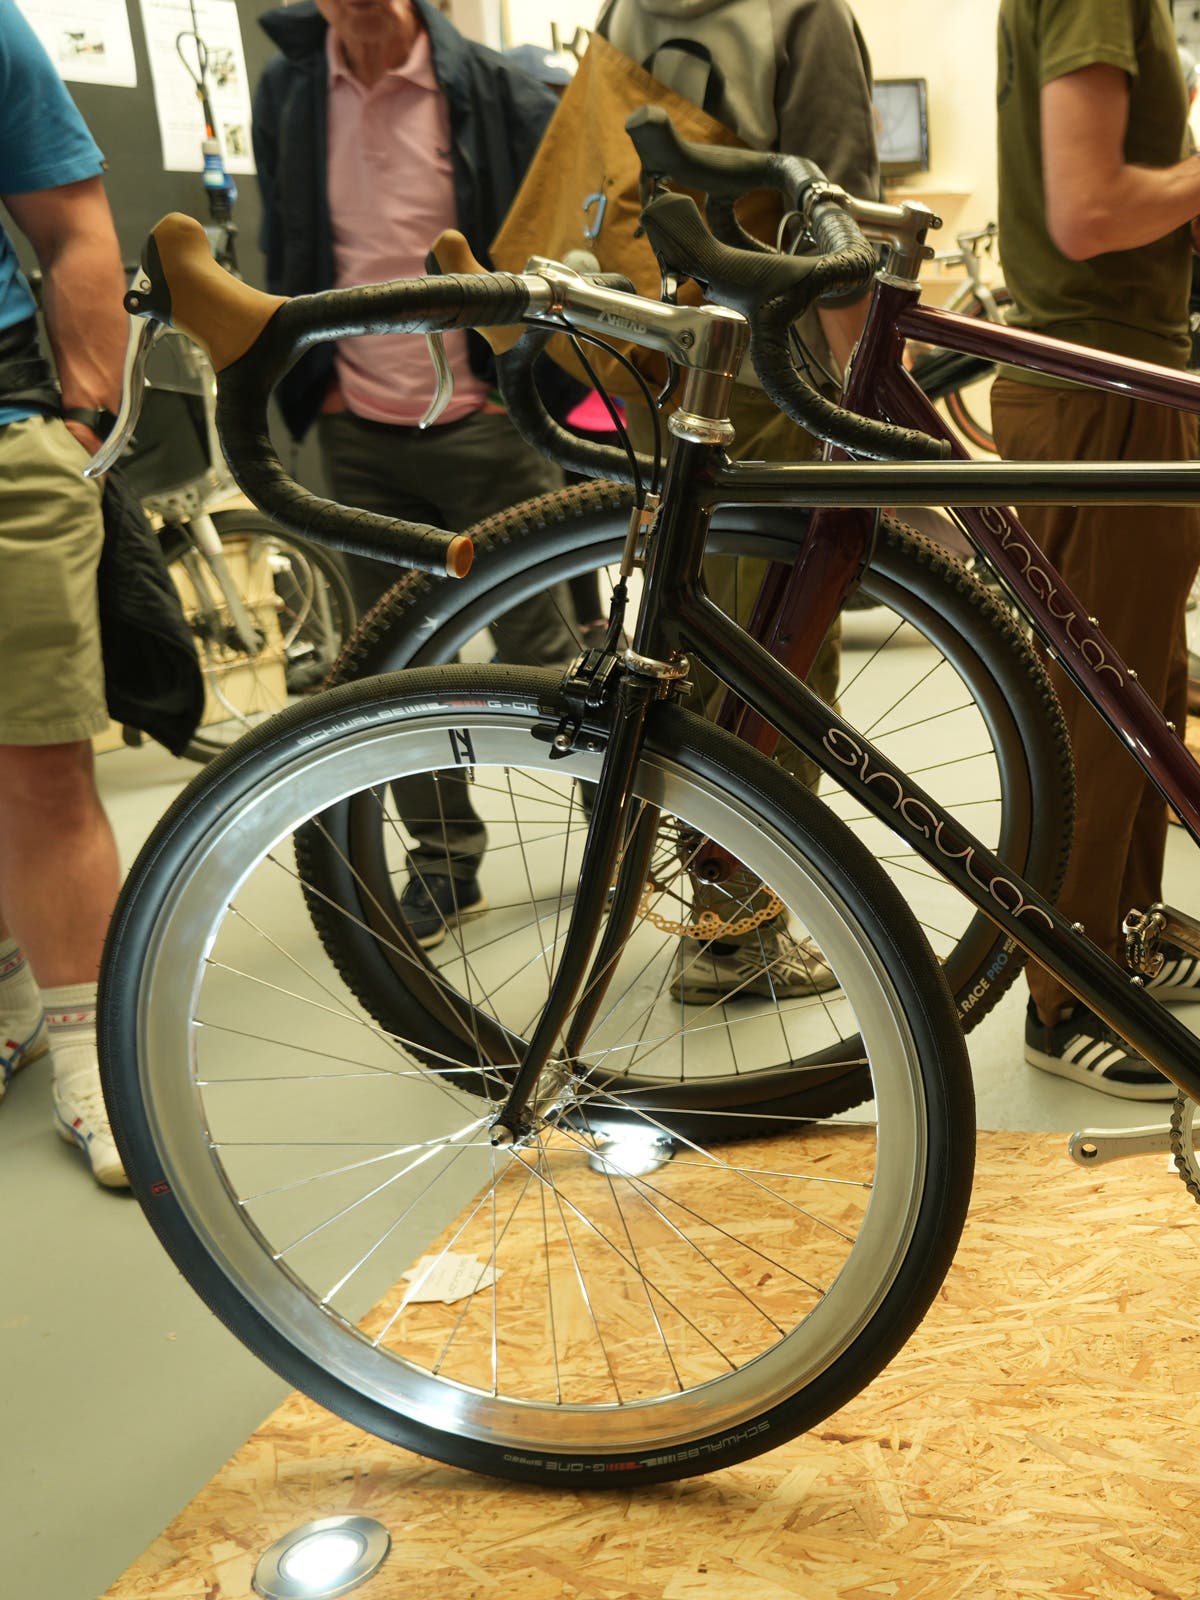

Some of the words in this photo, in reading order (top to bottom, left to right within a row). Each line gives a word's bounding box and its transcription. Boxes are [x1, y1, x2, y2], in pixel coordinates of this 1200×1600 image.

[297, 706, 405, 746] SCHWALBE
[961, 978, 990, 1012] RACE
[987, 953, 1008, 981] PRO
[677, 1420, 771, 1459] SCHWALBE
[503, 1454, 543, 1467] SPEED
[545, 1461, 605, 1473] G-ONE
